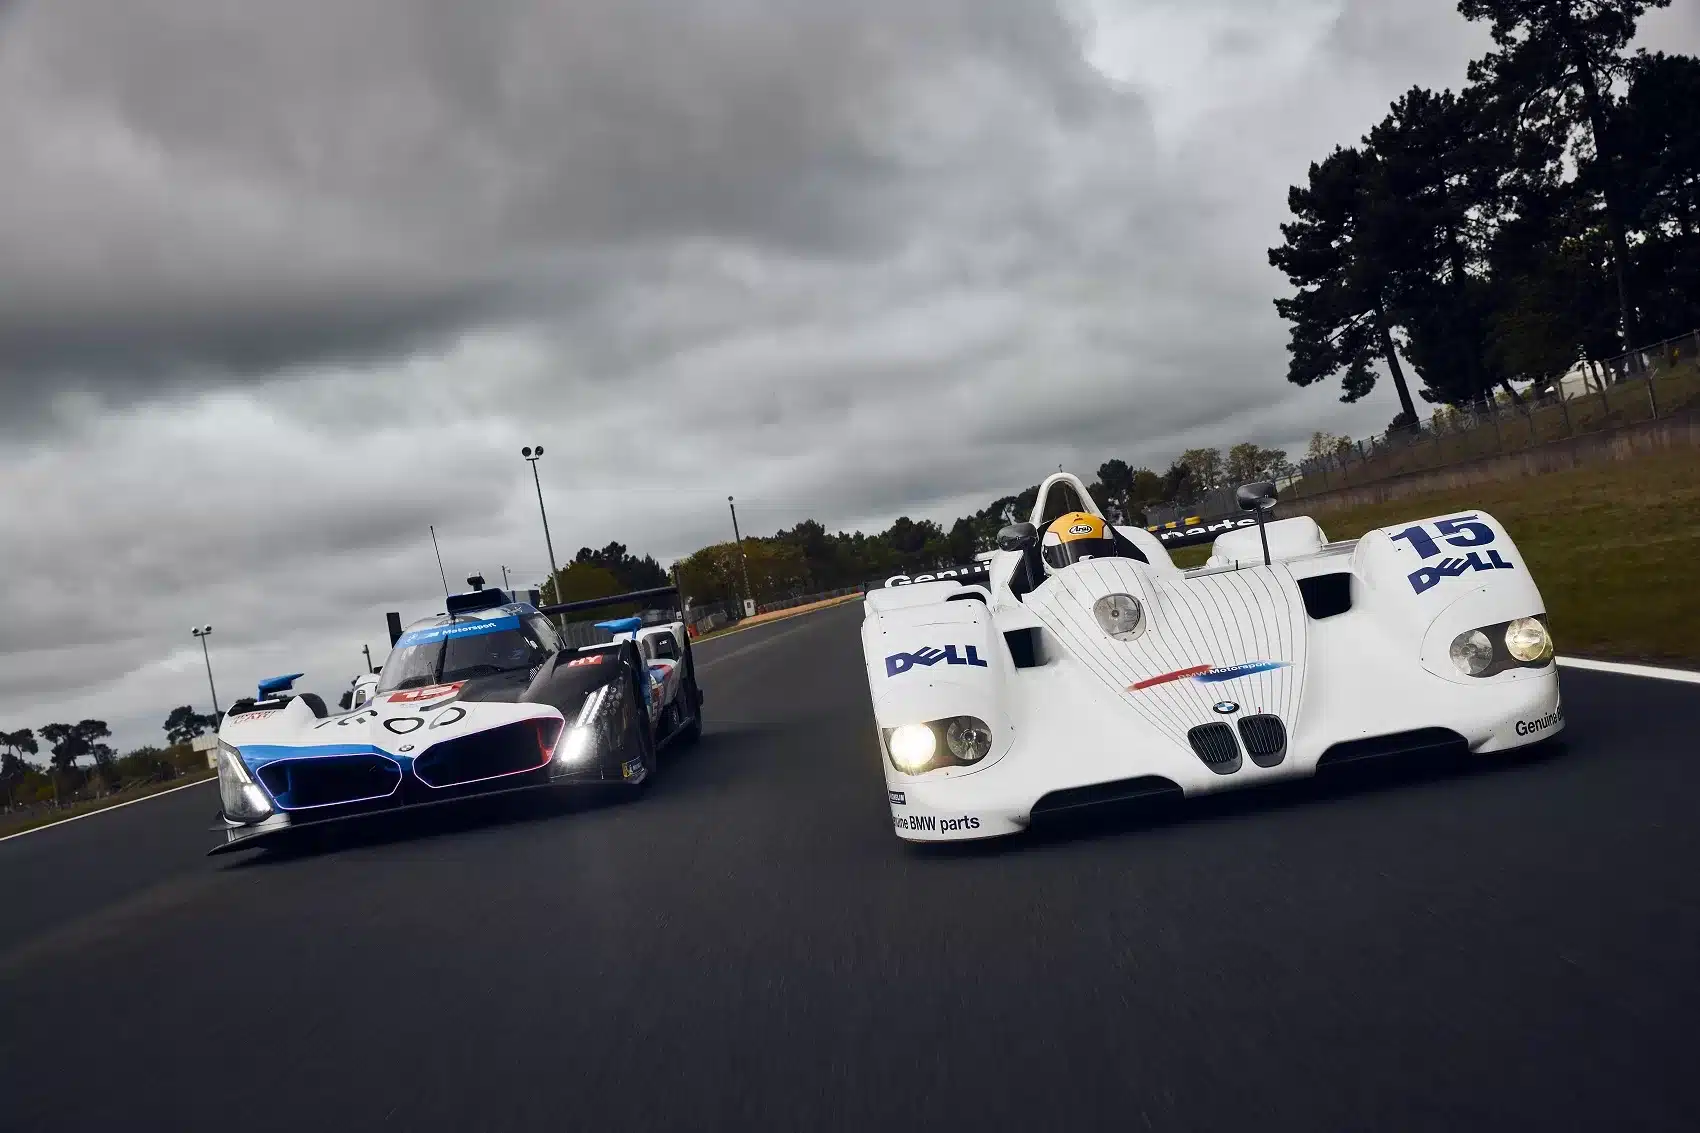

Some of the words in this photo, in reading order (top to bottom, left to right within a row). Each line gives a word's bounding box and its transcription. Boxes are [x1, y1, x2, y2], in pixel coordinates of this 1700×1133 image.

[1389, 514, 1496, 560] 15
[1407, 549, 1514, 595] DELL
[442, 622, 496, 636] Motorsport
[885, 644, 988, 678] DELL
[1209, 660, 1272, 675] Motorsport
[1515, 712, 1558, 736] Genuine
[909, 815, 936, 831] BMW
[940, 815, 980, 834] parts
